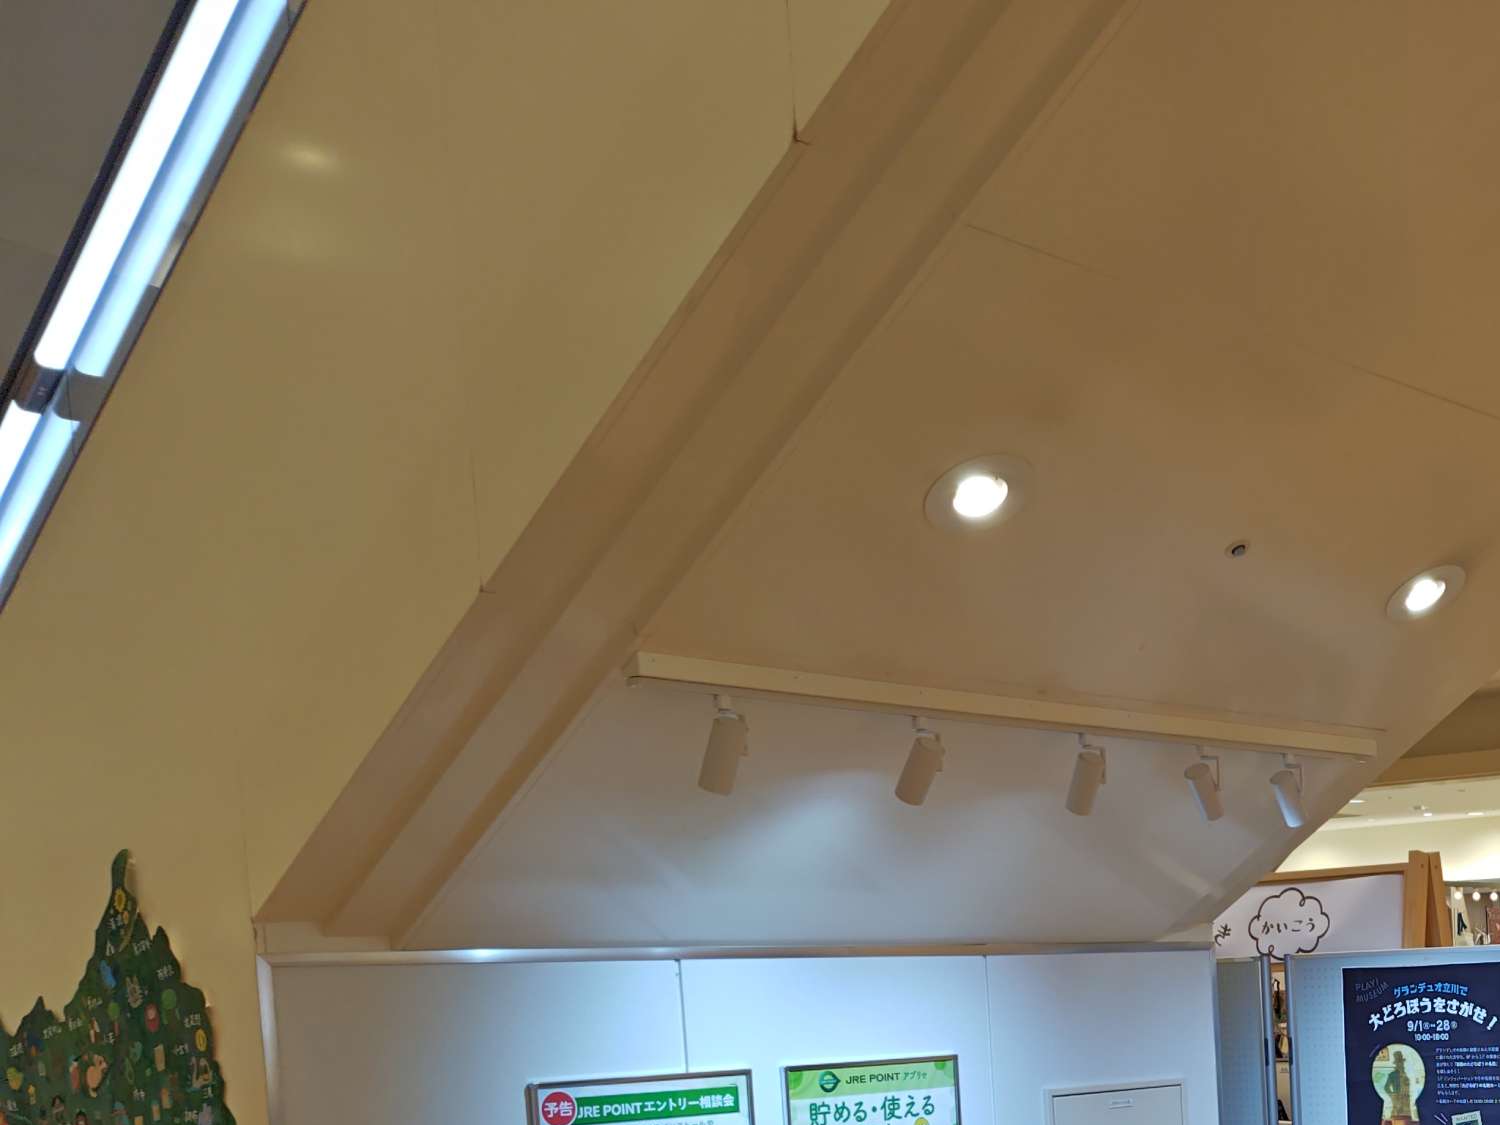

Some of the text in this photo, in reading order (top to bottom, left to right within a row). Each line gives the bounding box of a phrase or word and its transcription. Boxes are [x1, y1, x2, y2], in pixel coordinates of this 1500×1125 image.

[1261, 917, 1316, 935] かいこう
[1356, 982, 1390, 1003] MUSEUM
[846, 1074, 867, 1085] JRE
[869, 1072, 900, 1083] POINT
[543, 1102, 574, 1119] 予告
[577, 1103, 601, 1119] JRE
[603, 1102, 642, 1117] POINT
